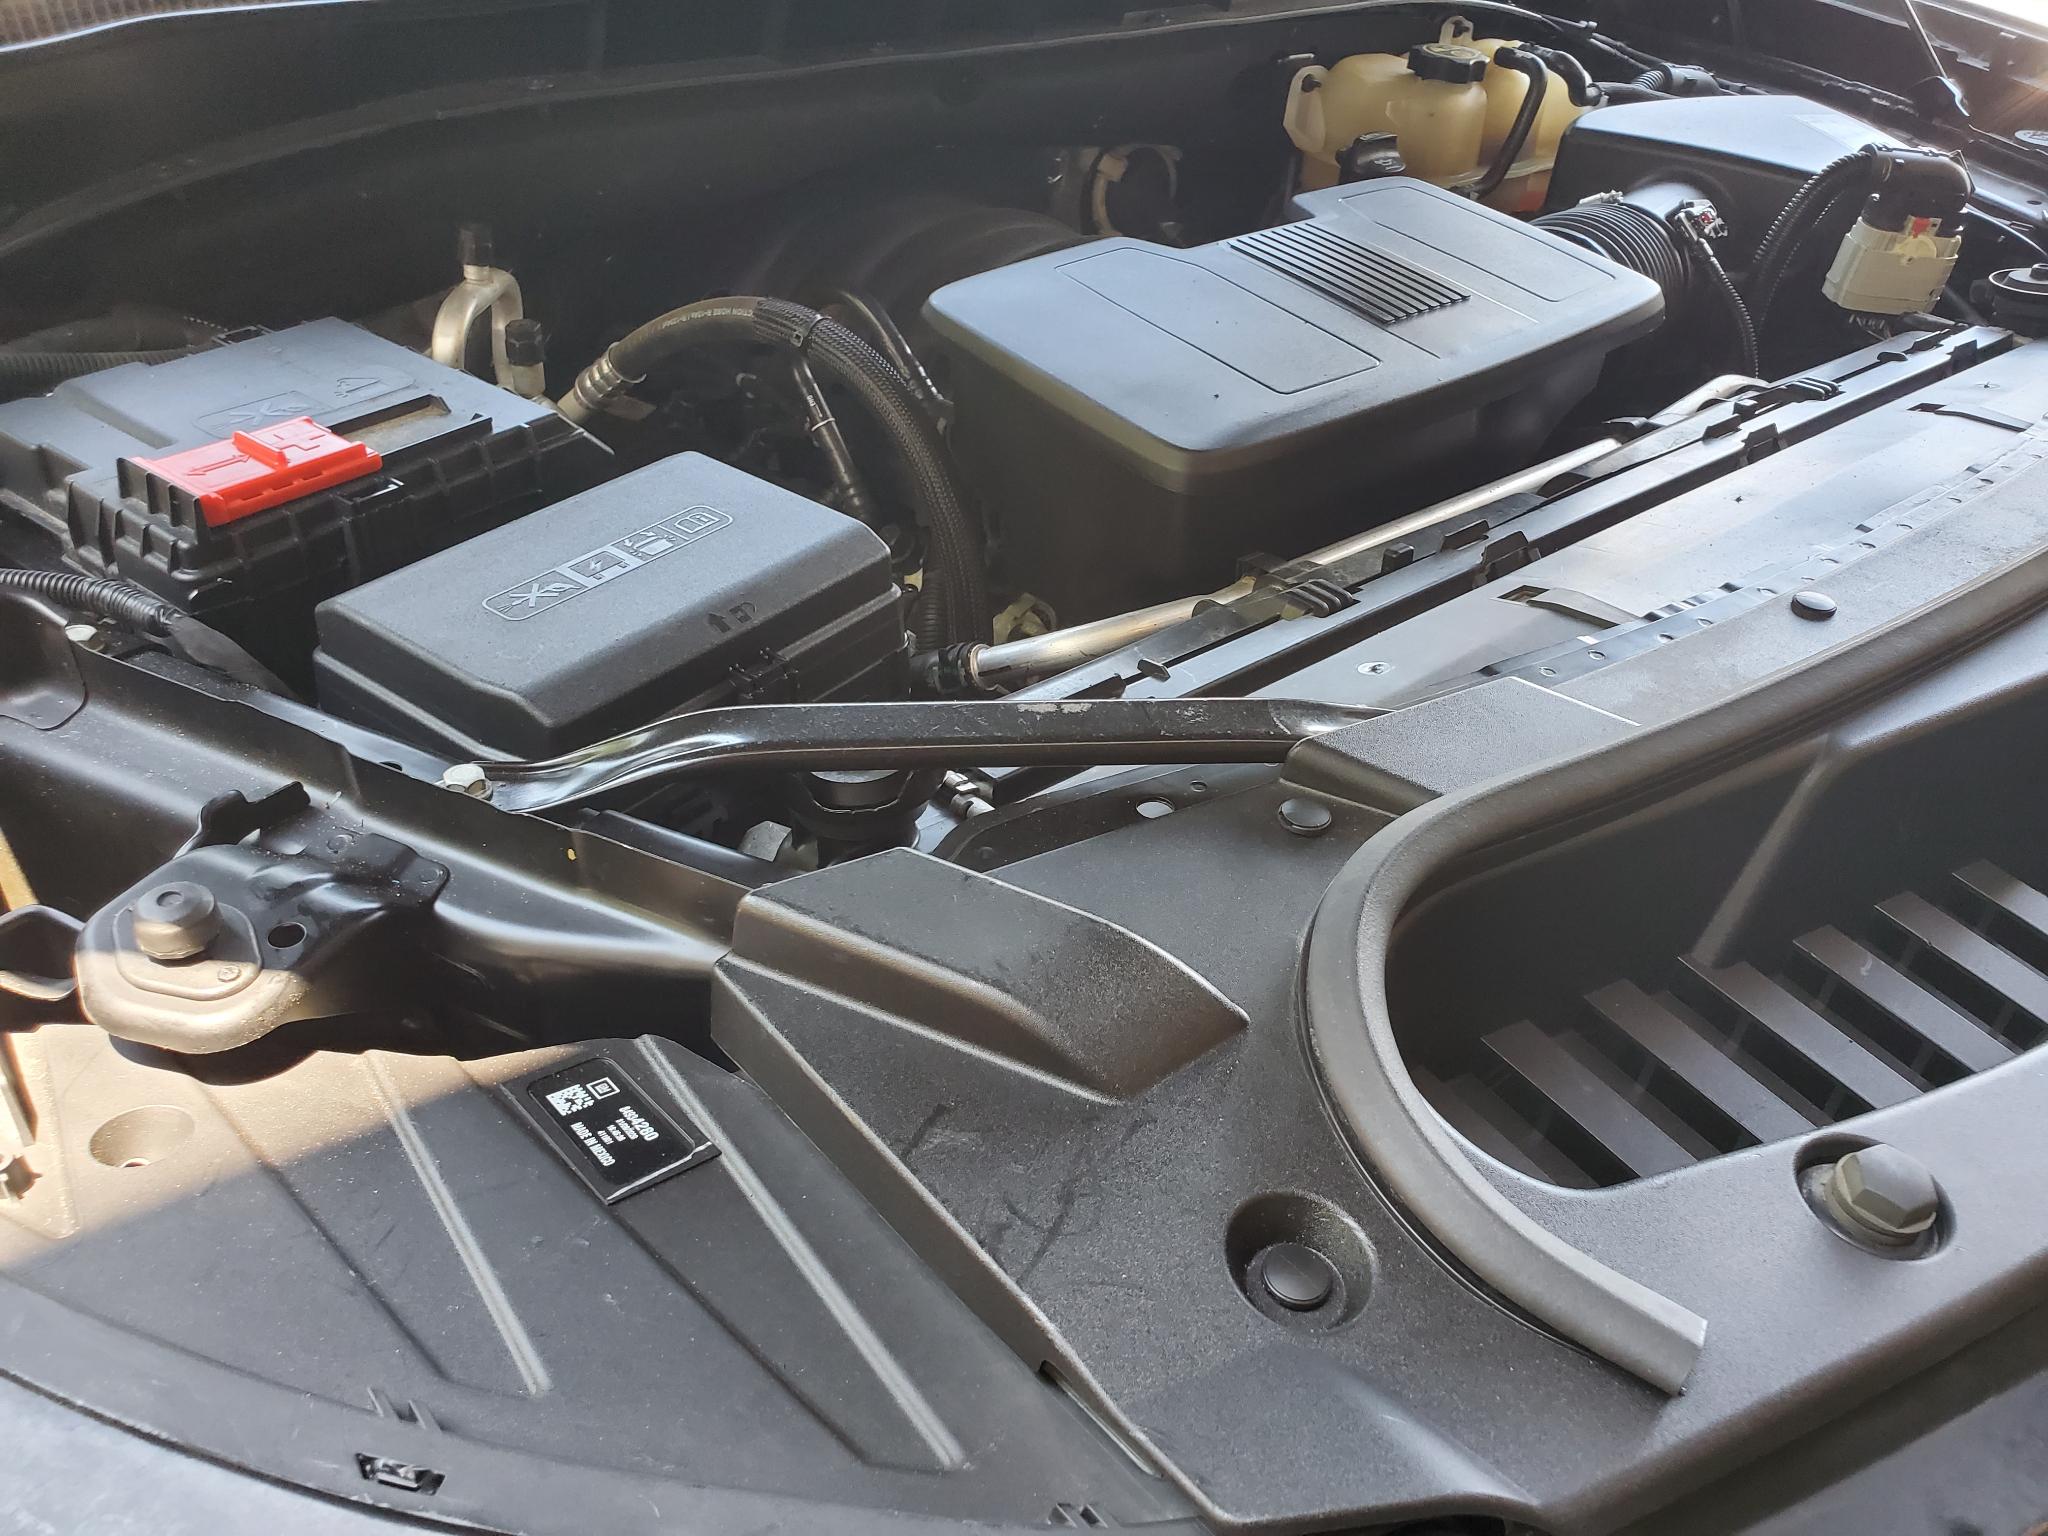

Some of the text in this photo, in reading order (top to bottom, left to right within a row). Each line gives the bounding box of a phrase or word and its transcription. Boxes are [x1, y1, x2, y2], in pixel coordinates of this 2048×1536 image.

[570, 1121, 593, 1140] MADE
[583, 1136, 599, 1147] IN
[589, 1143, 616, 1167] MEXICO
